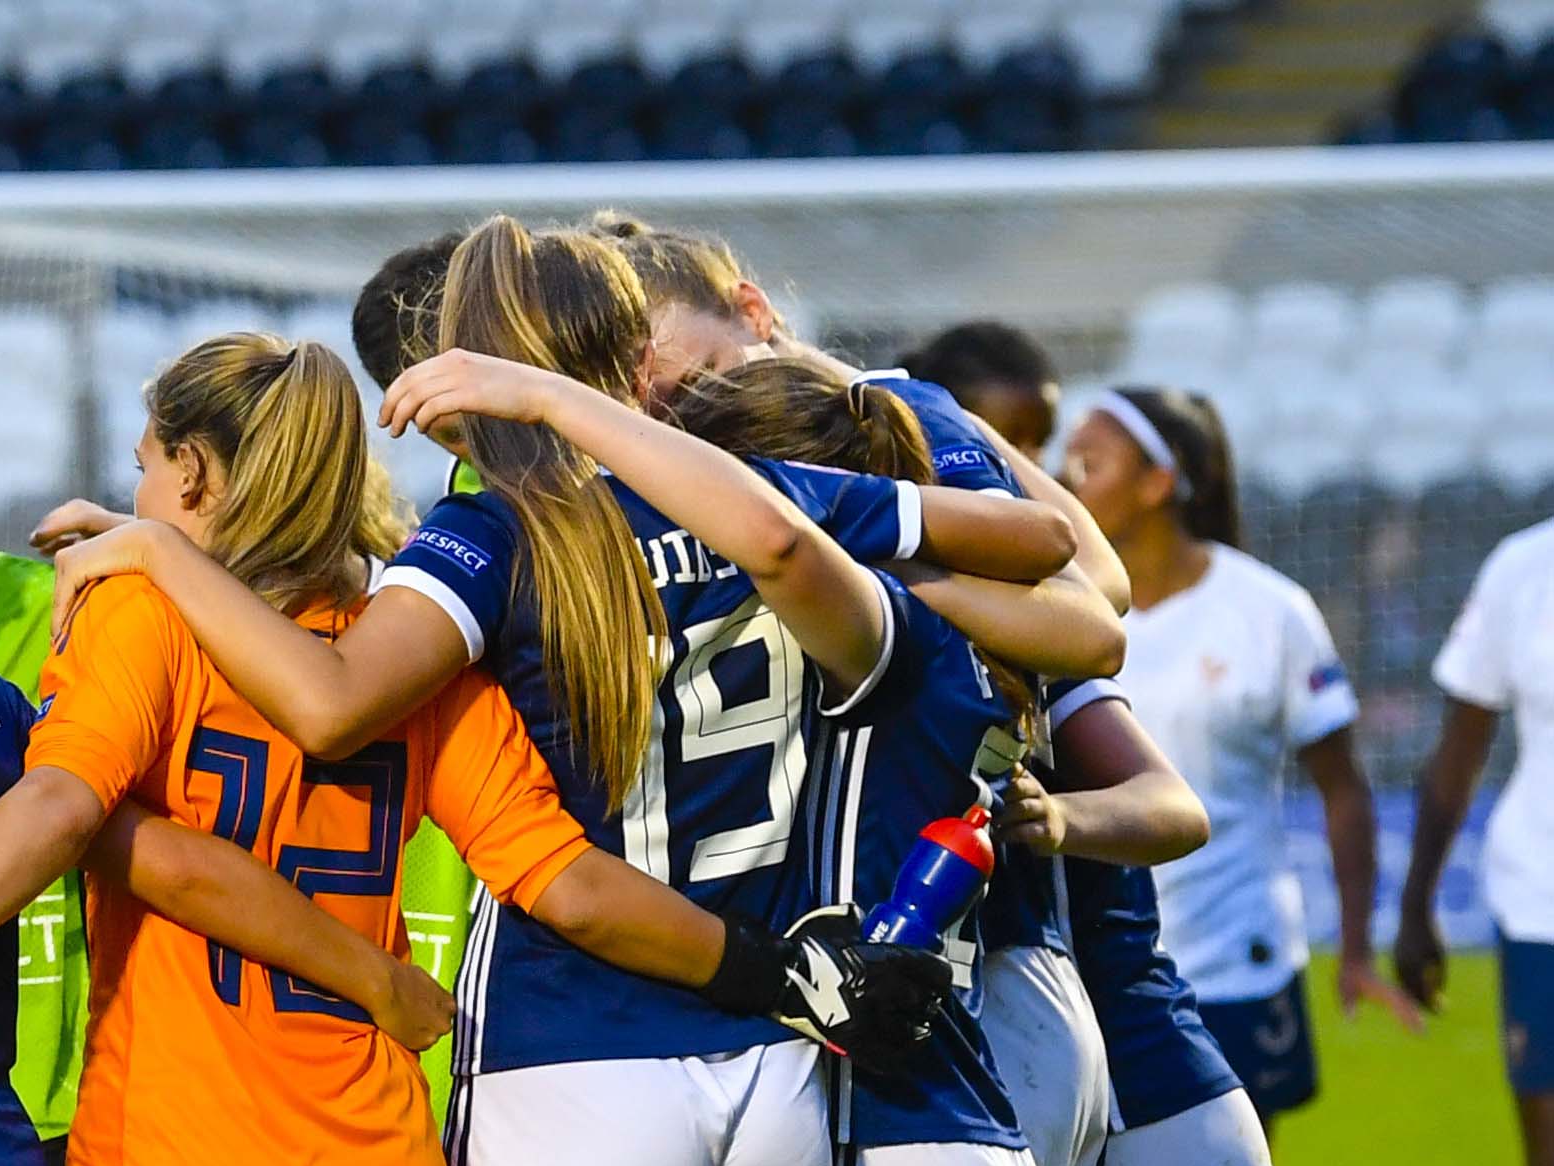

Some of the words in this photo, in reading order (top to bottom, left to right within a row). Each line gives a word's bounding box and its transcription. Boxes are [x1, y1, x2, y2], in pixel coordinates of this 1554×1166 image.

[932, 450, 980, 470] SPECT
[416, 531, 488, 570] RESPECT
[187, 725, 409, 1028] 12
